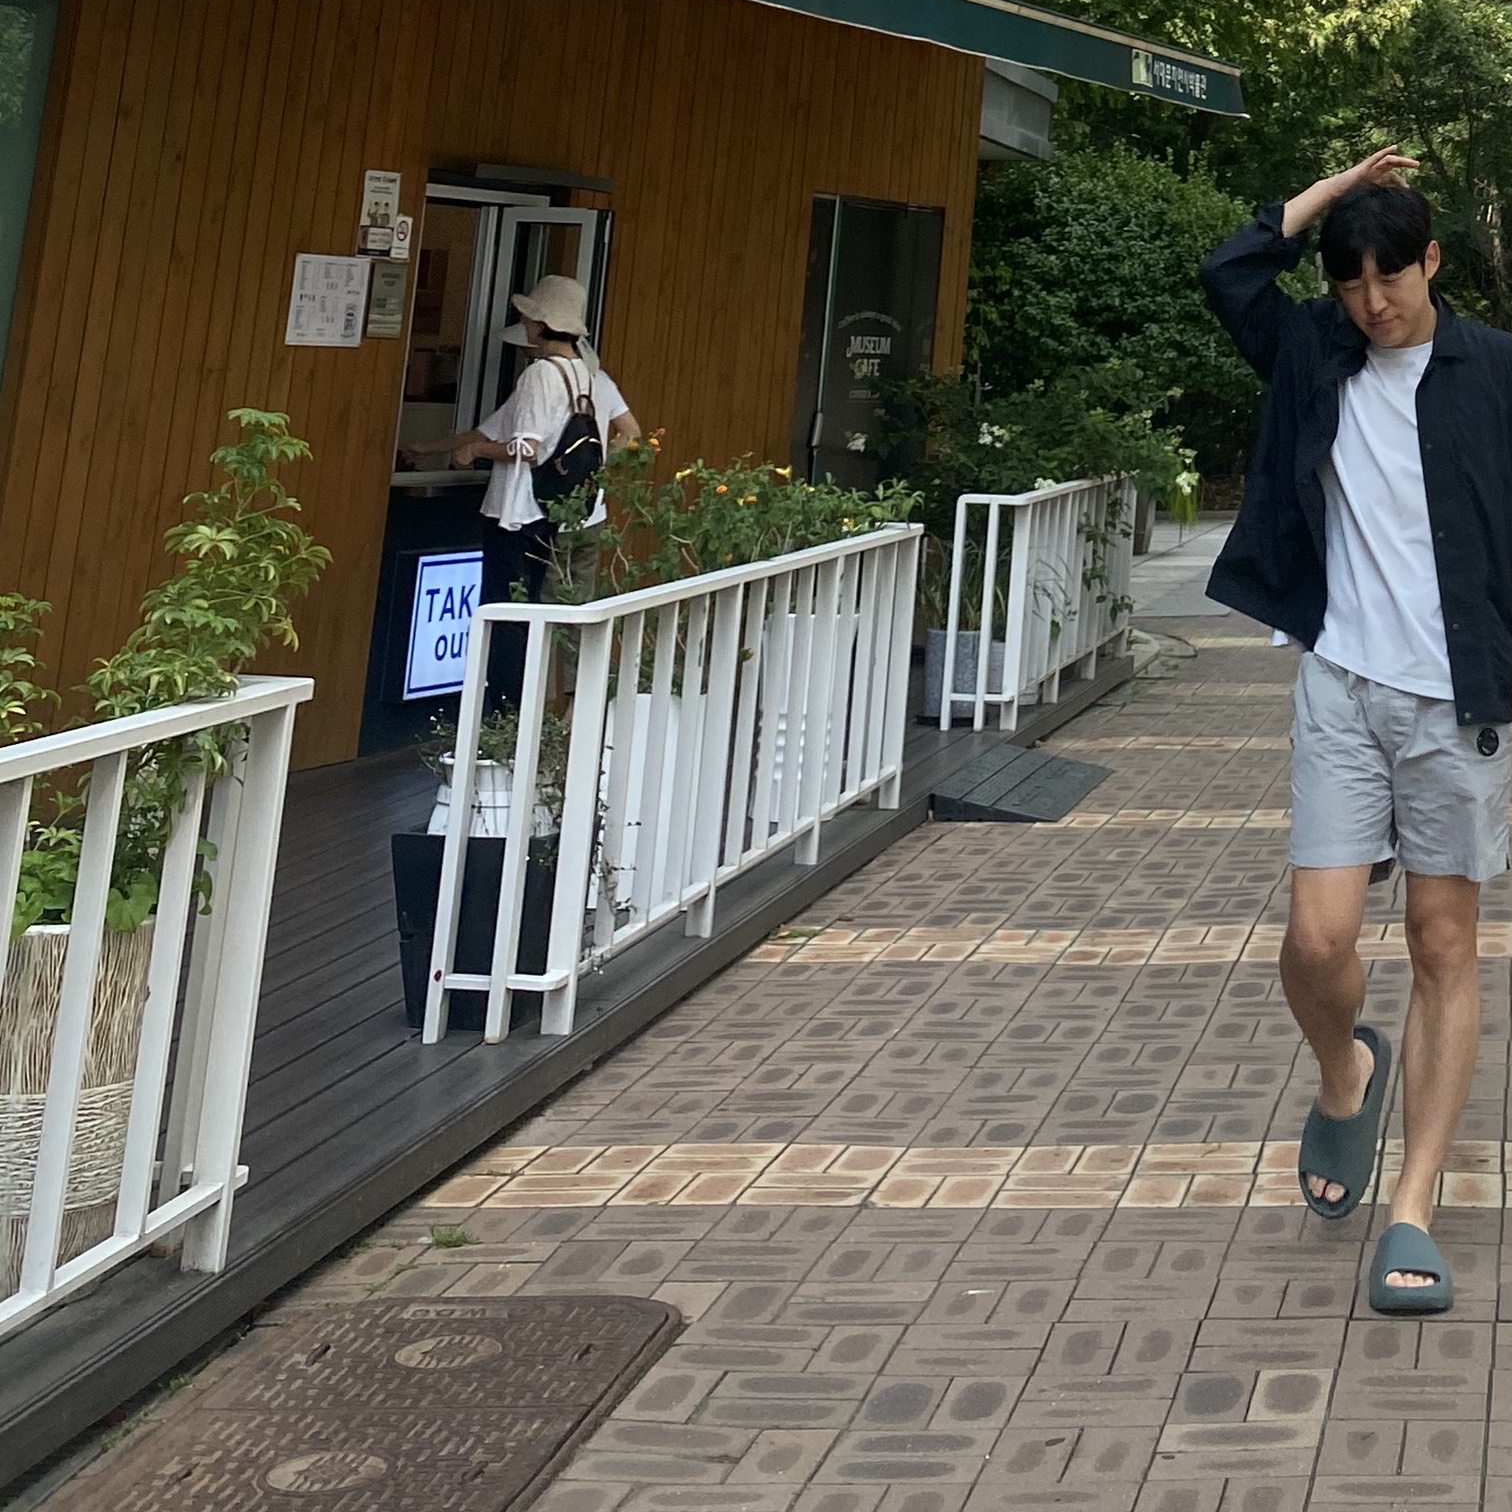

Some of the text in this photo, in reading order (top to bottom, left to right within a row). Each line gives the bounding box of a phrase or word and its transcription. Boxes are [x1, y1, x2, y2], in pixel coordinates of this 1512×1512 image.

[846, 335, 892, 358] MUSEUM
[854, 358, 881, 378] CAFE
[426, 584, 477, 623] TAK
